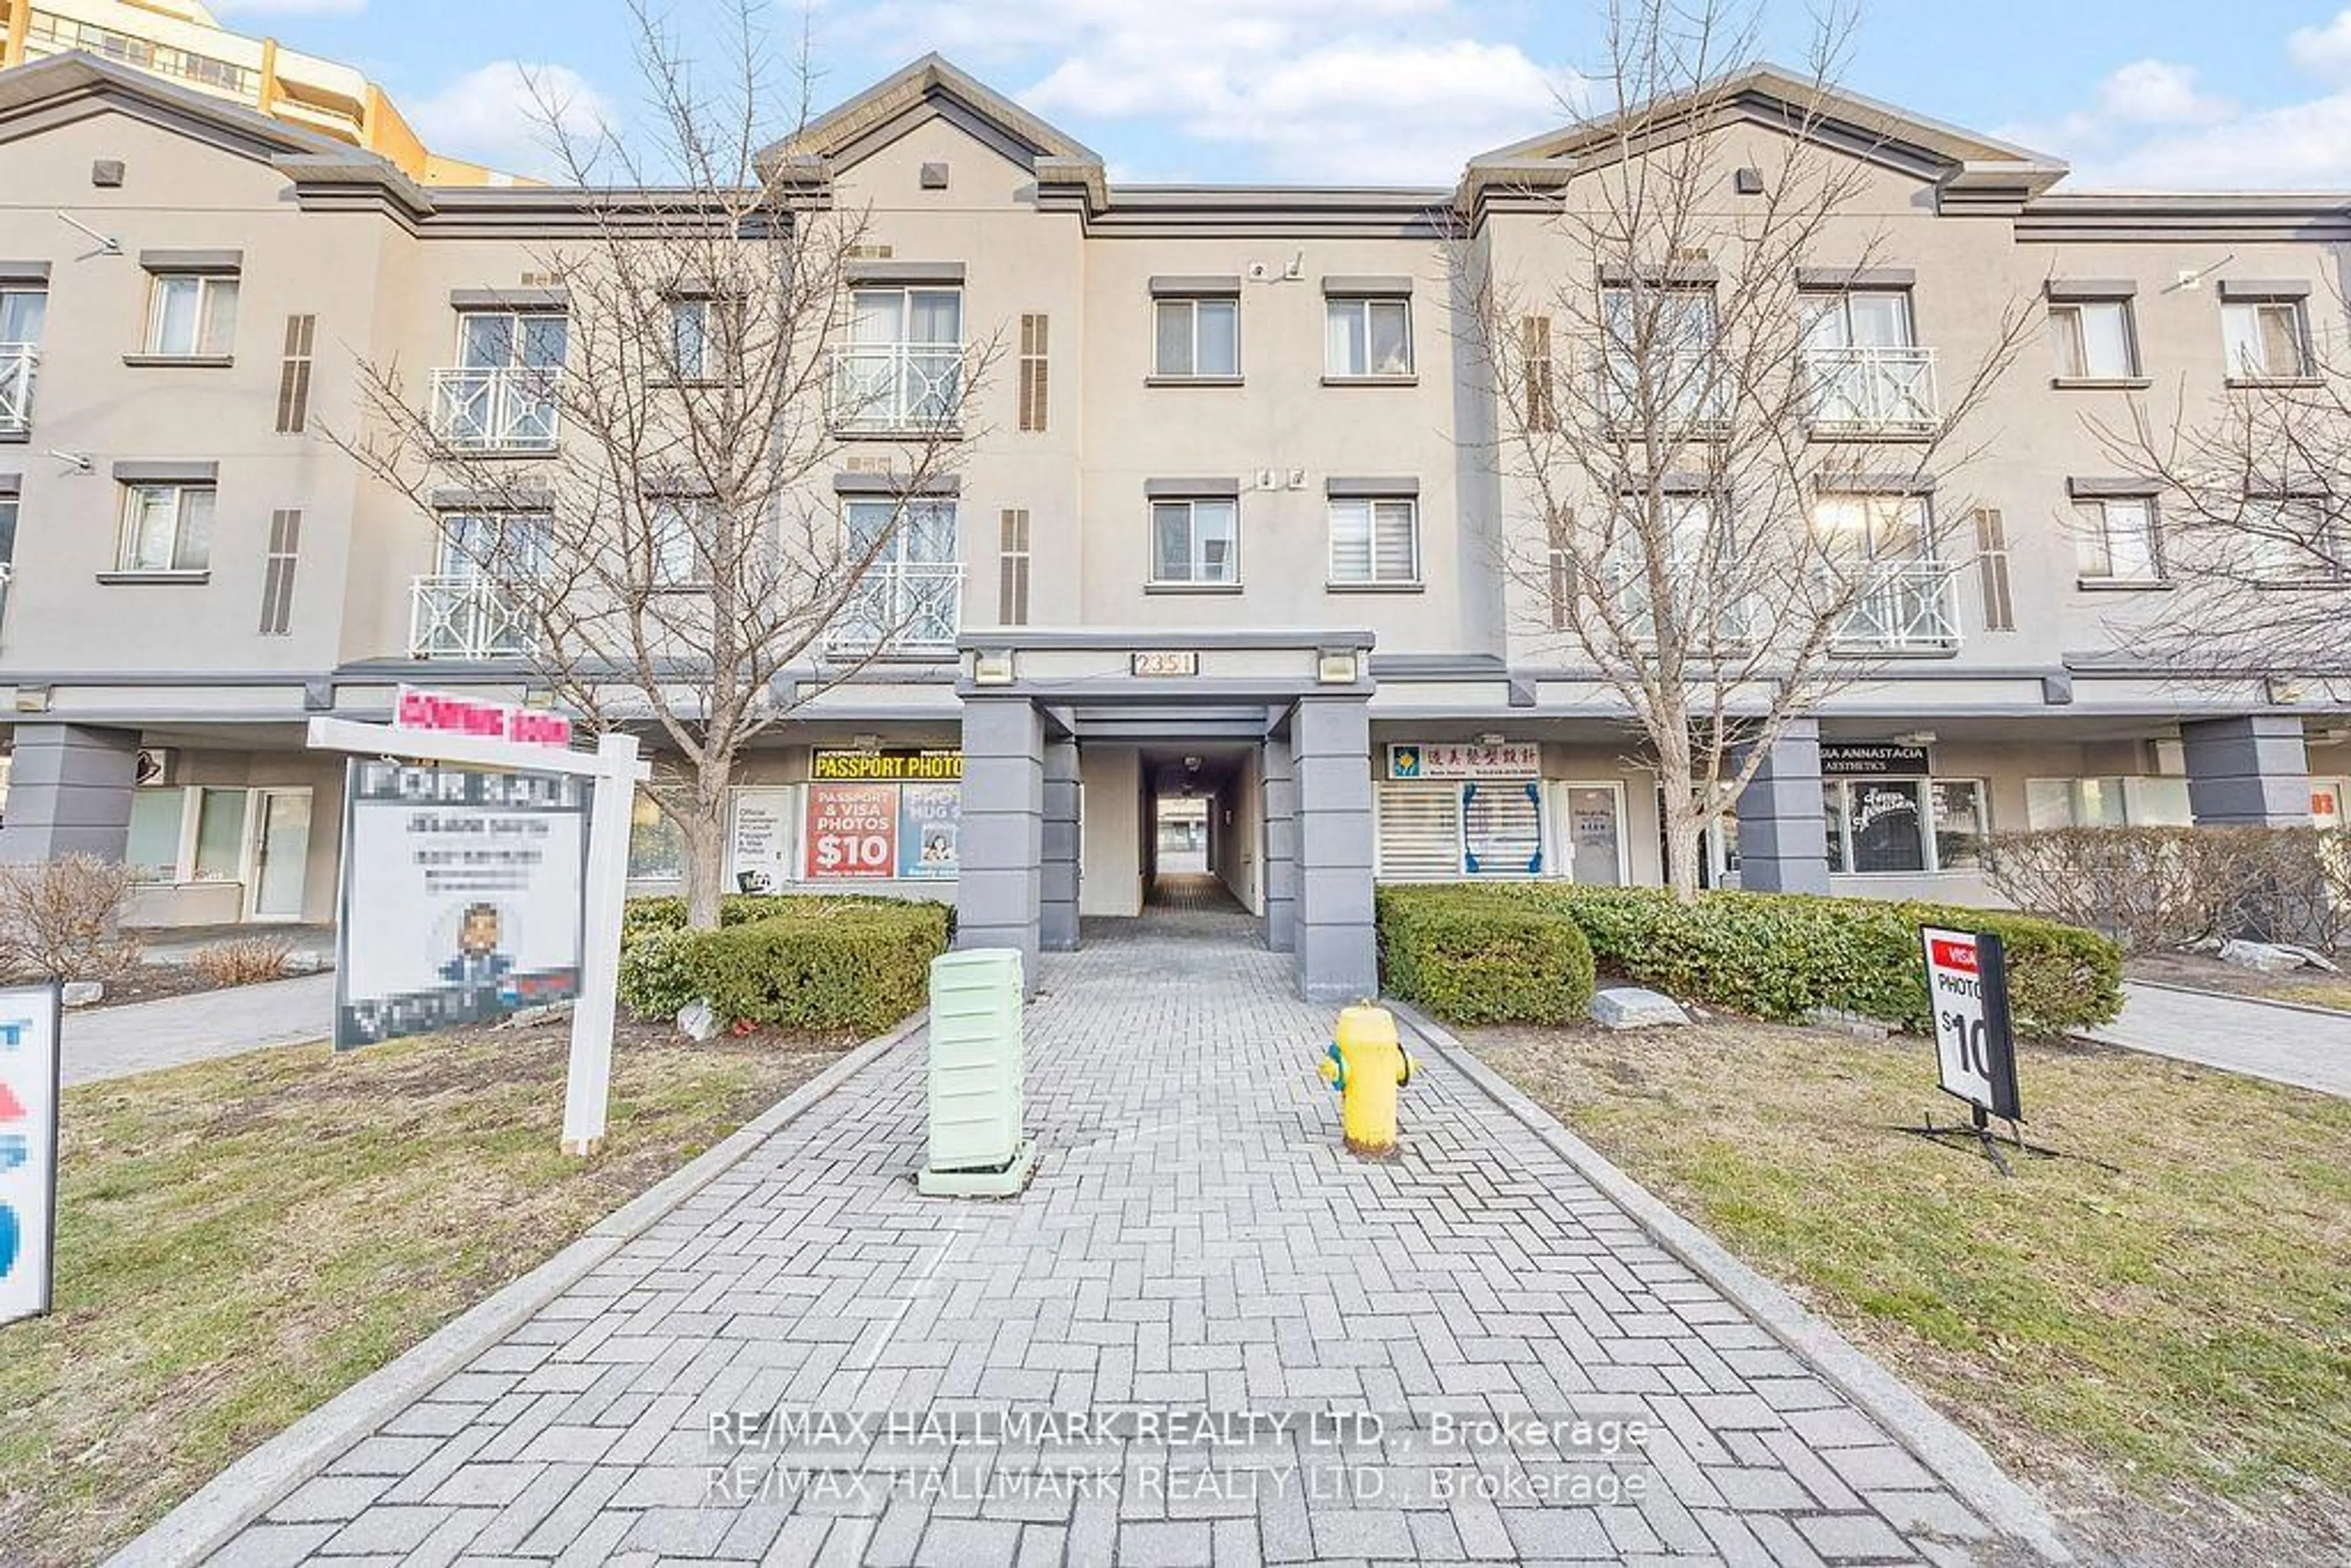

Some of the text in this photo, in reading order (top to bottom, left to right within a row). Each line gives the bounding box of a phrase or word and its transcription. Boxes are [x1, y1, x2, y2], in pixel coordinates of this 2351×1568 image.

[1842, 748, 1923, 759] ANNASTACIA
[815, 757, 962, 777] PASSPORT PHOTO
[1826, 761, 1887, 770] AESTHETICS
[819, 792, 890, 803] PASSPORT
[825, 804, 880, 816] & VISA
[817, 817, 890, 830] PHOTOS
[816, 834, 888, 869] $10
